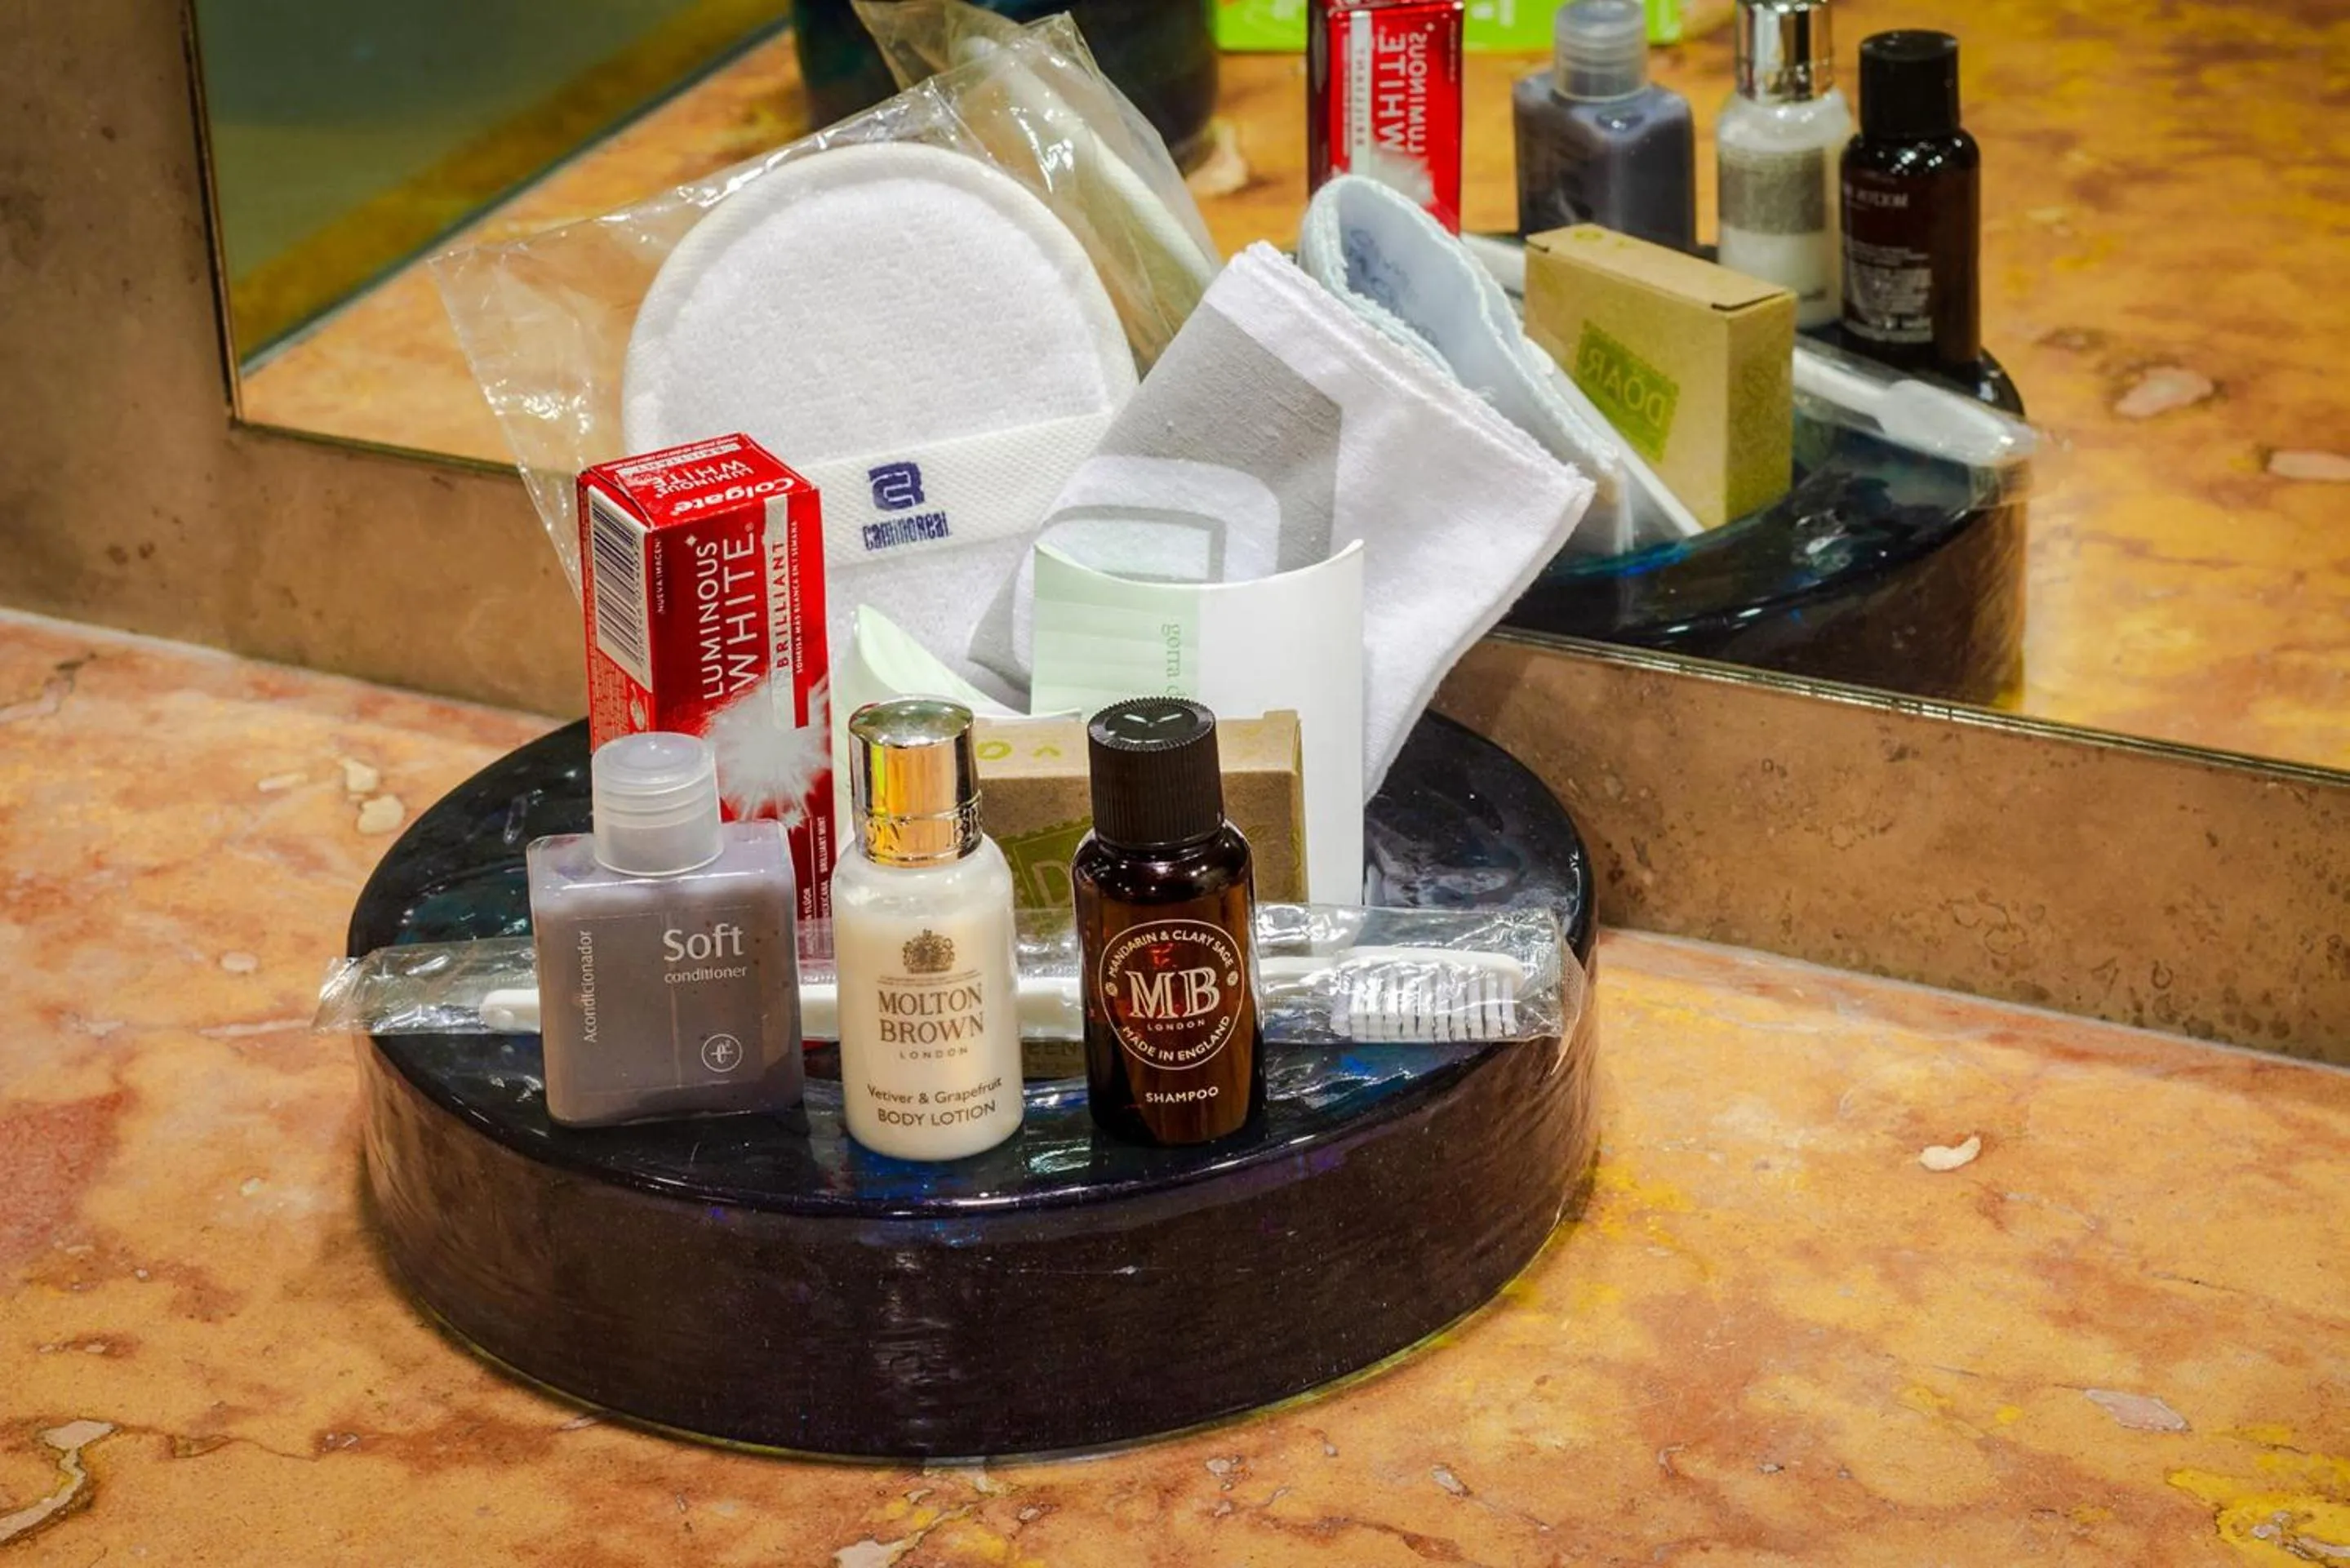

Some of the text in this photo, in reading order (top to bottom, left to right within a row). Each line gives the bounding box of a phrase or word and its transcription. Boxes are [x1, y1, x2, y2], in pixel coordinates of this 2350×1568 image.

[654, 459, 746, 487] WHITE
[673, 477, 795, 514] Colgate
[696, 541, 724, 700] LUMINOUS
[722, 531, 760, 693] WHITE
[772, 541, 789, 669] BRILLIANT
[662, 922, 744, 962] Soft
[1108, 930, 1234, 979] MANDARIN & CLARY SAGE
[576, 929, 597, 1043] Acondicionador
[664, 965, 748, 984] conditioner
[877, 982, 983, 1016] MOLTON
[1125, 966, 1220, 1019] MB
[879, 1011, 984, 1044] BROWN
[1122, 1015, 1230, 1061] MADE IN ENGLAND
[1147, 1019, 1206, 1031] LONDON
[899, 1046, 968, 1059] LONDON
[867, 1077, 1002, 1104] Vetiver & Grapefruit
[1145, 1086, 1219, 1103] SHAMPOO
[877, 1099, 996, 1126] BODY LOTION
